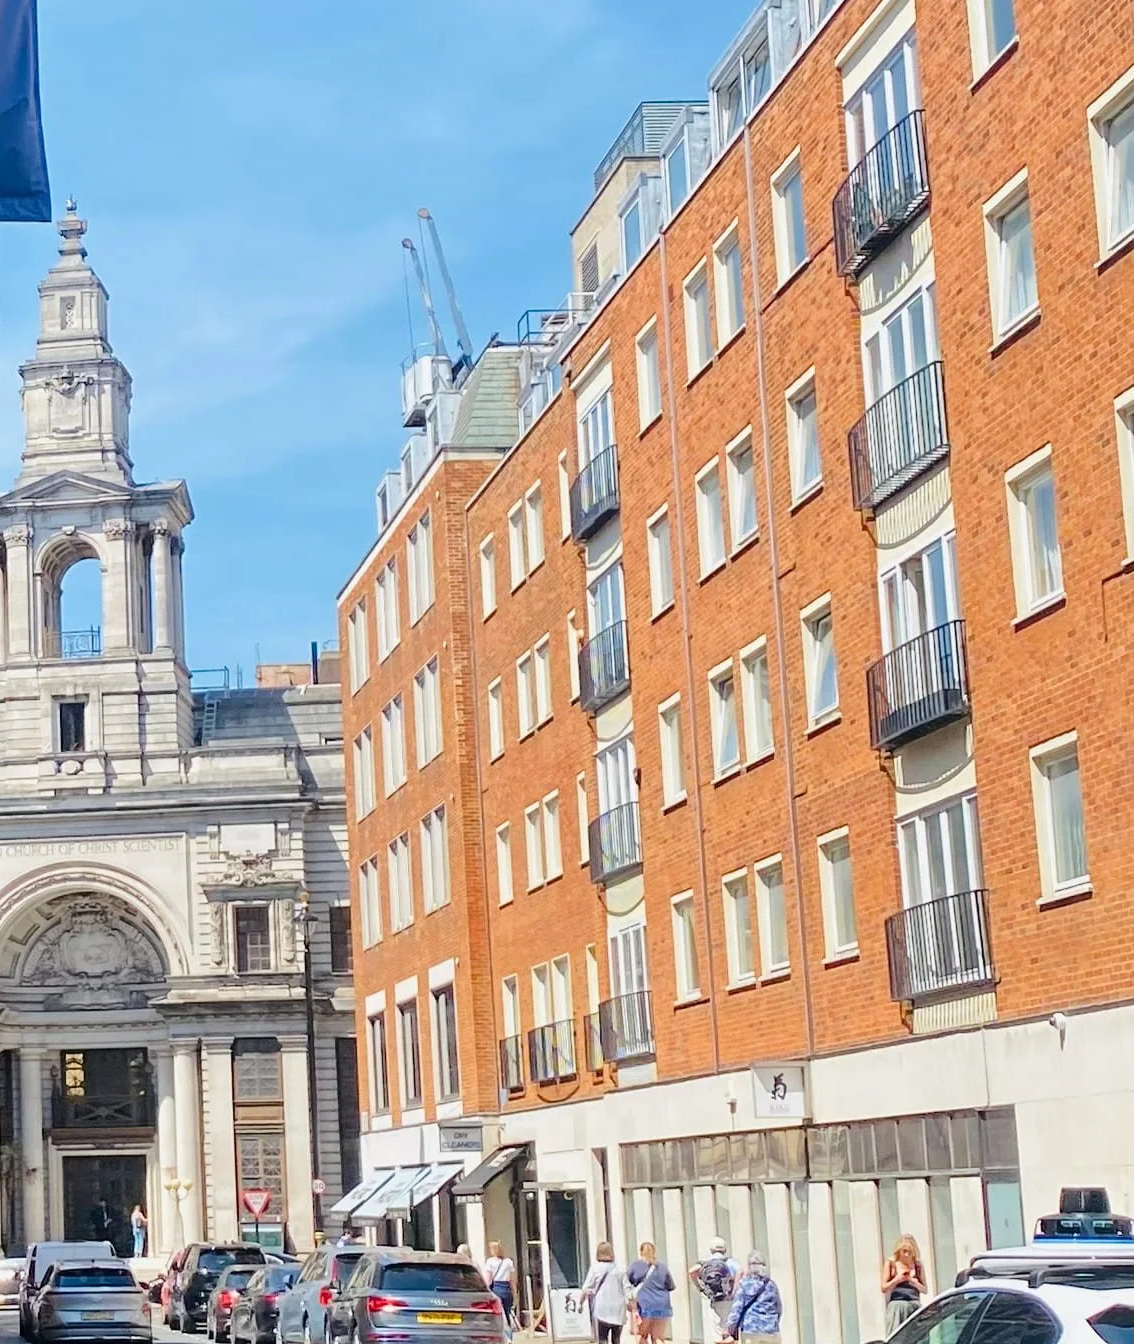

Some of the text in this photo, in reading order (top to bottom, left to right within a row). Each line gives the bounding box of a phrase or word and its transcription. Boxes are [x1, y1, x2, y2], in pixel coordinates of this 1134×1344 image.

[6, 843, 55, 857] CHURCH
[58, 843, 75, 856] OF
[78, 840, 117, 854] CHRIST
[122, 838, 179, 853] SCIENTIST
